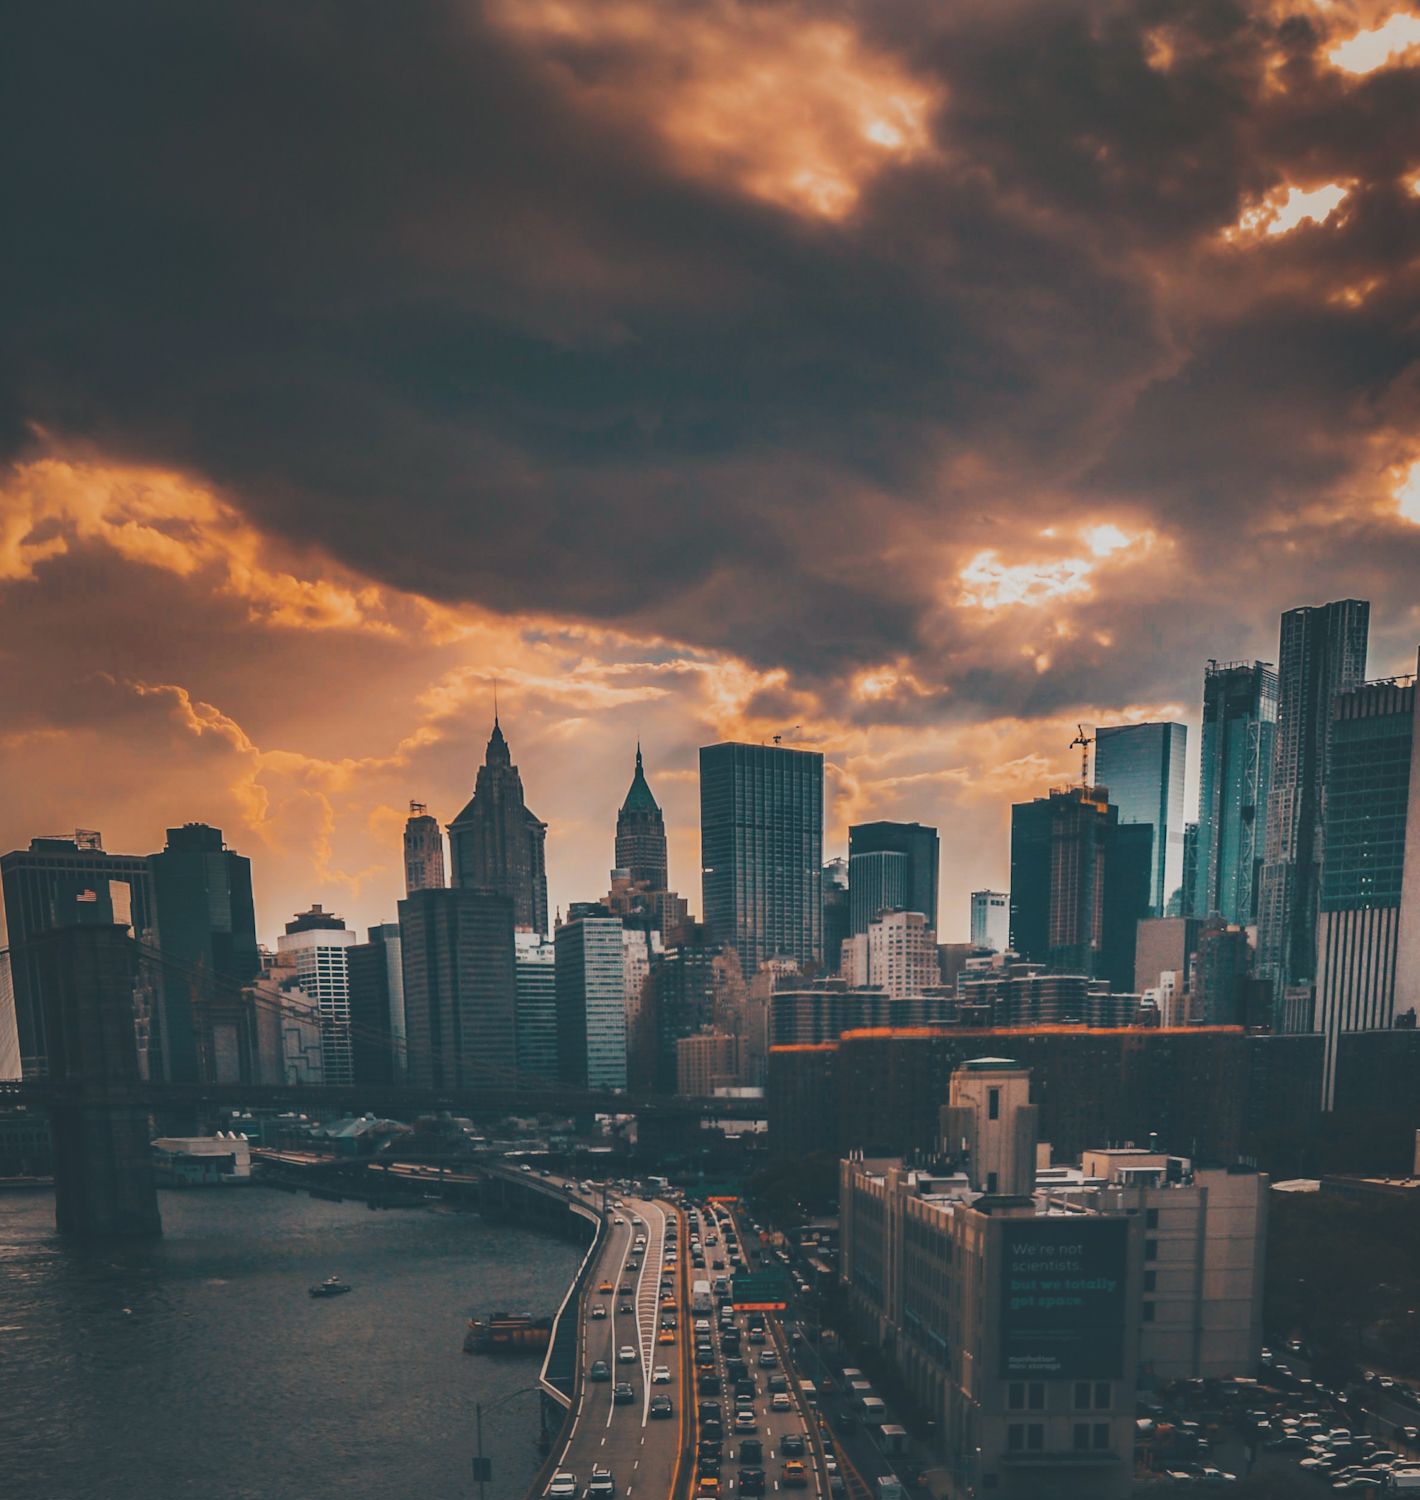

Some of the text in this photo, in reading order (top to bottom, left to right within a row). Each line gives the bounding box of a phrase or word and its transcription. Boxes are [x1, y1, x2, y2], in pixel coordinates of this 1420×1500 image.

[1012, 1242, 1083, 1255] We're not
[1011, 1278, 1116, 1292] but we totally
[1010, 1296, 1034, 1310] got
